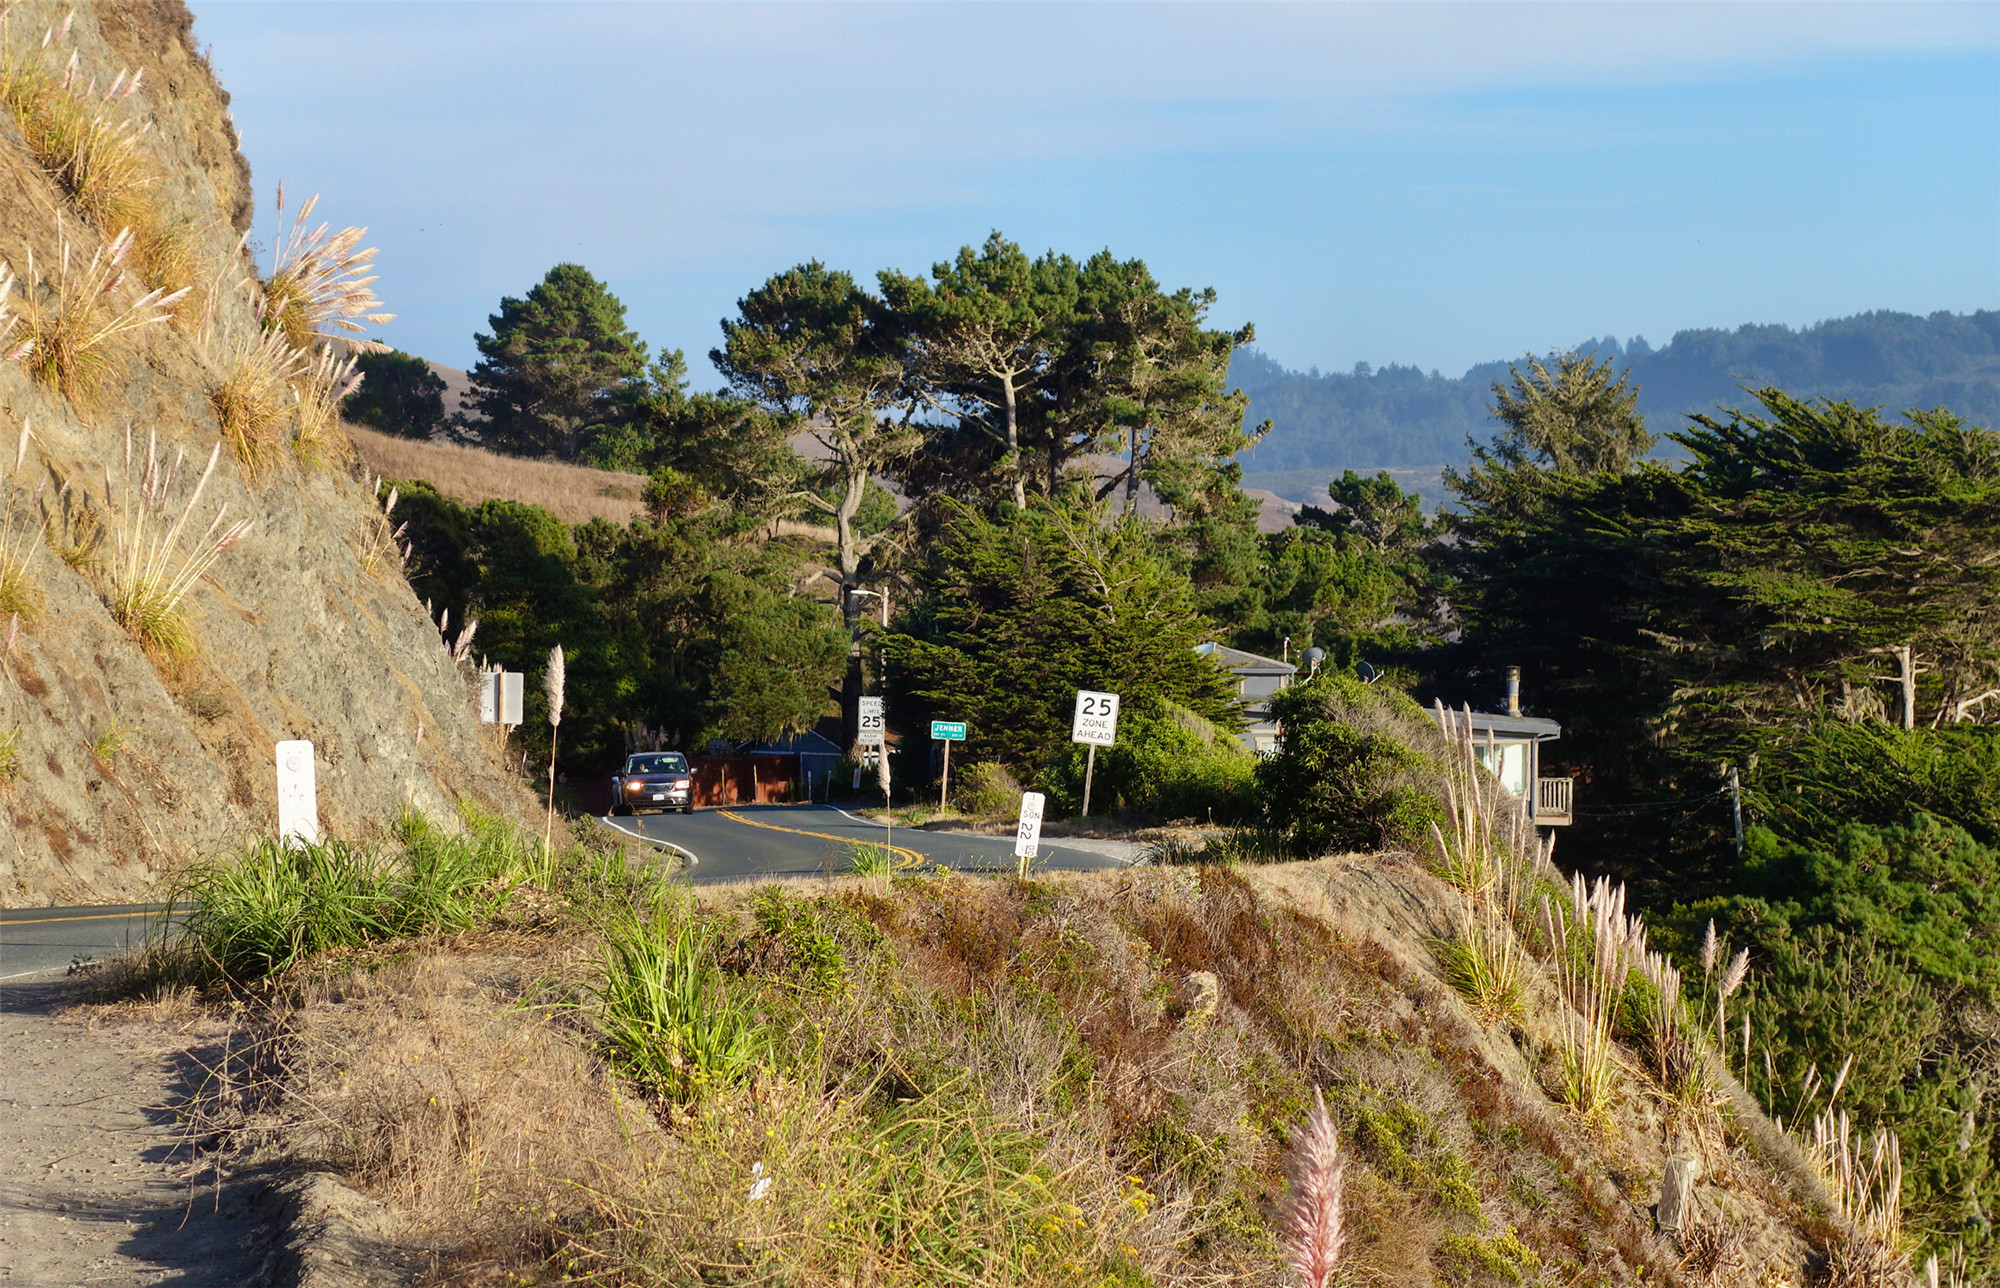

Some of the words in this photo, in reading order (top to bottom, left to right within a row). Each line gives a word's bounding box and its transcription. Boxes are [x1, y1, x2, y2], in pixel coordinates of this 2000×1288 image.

[1082, 697, 1111, 717] 25
[862, 715, 881, 728] 25
[1082, 718, 1109, 729] ZONE
[934, 724, 963, 733] JENNER
[1076, 729, 1111, 741] AHEAD
[1023, 810, 1040, 819] SON
[1020, 822, 1034, 840] 22
